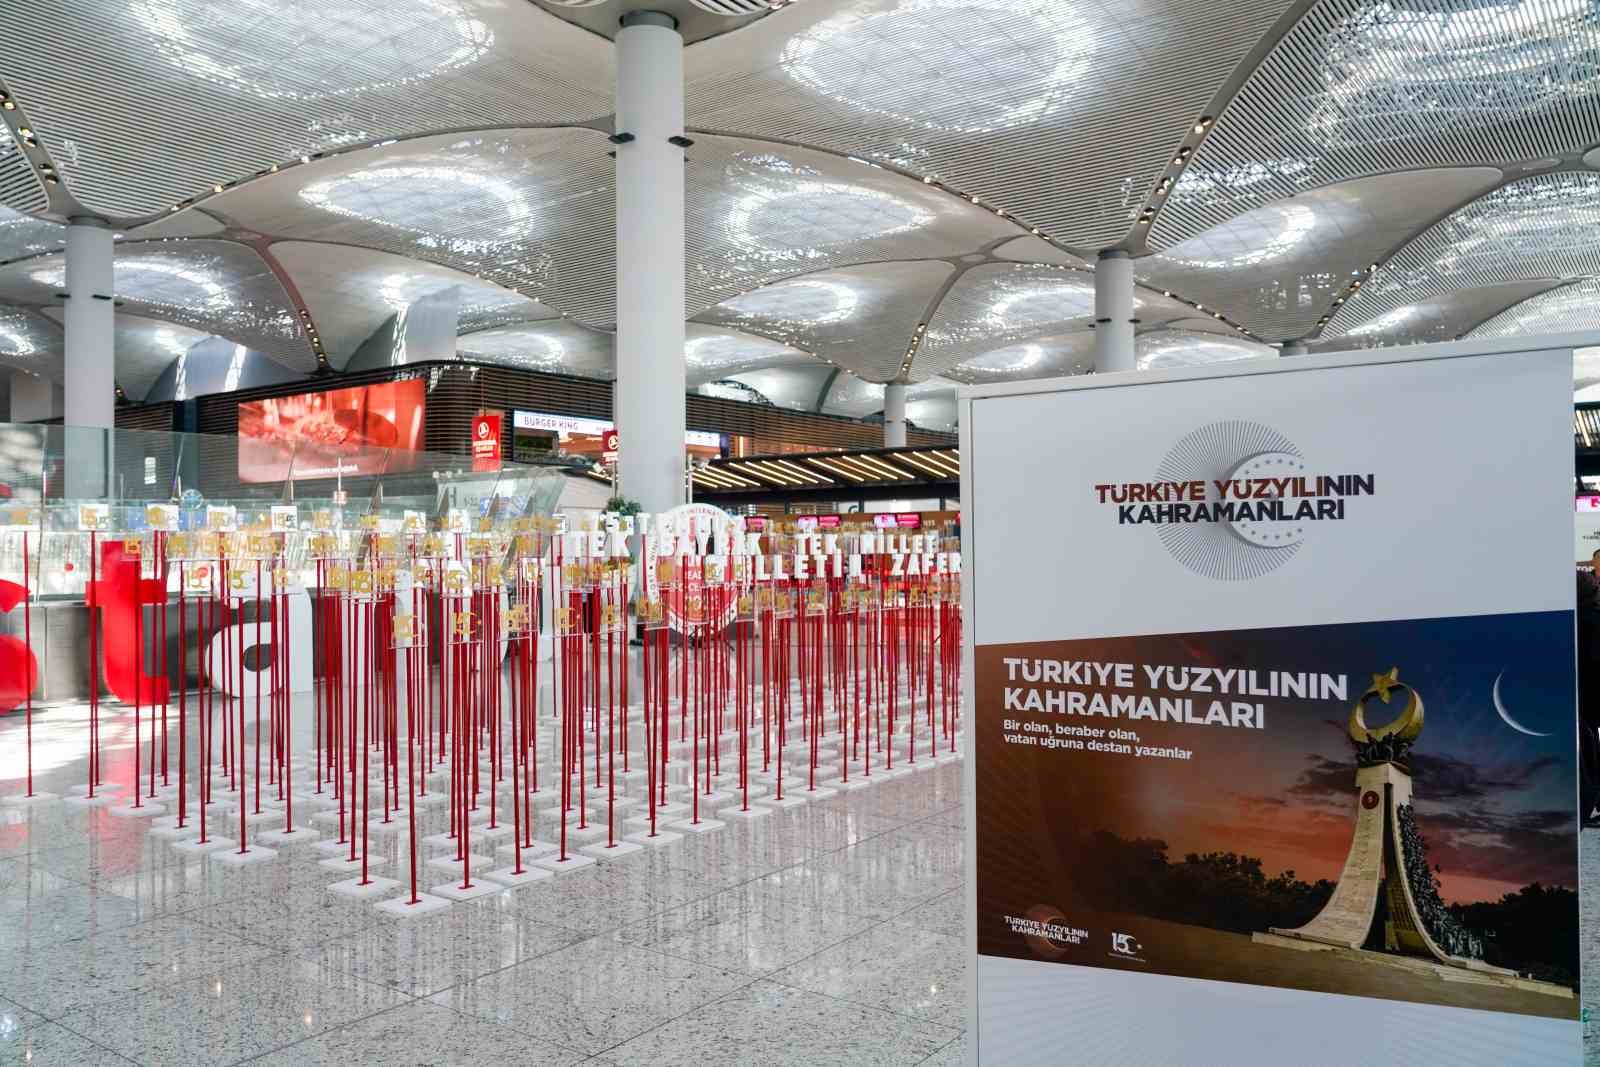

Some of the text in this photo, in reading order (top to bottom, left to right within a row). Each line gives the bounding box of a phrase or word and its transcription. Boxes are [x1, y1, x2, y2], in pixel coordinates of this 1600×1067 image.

[524, 416, 557, 428] BURGER
[1095, 474, 1374, 504] TÜRKİYE YÜZYILININ
[1118, 499, 1345, 525] KAHRAMANLARI
[1003, 657, 1348, 701] TÜRKİYE YÜZYILININ
[1003, 687, 1265, 729] KAHRAMANLARI
[1003, 719, 1141, 743] Bir olan, beraber olan,
[1003, 733, 1193, 760] vatan uğruna destan yazanlar
